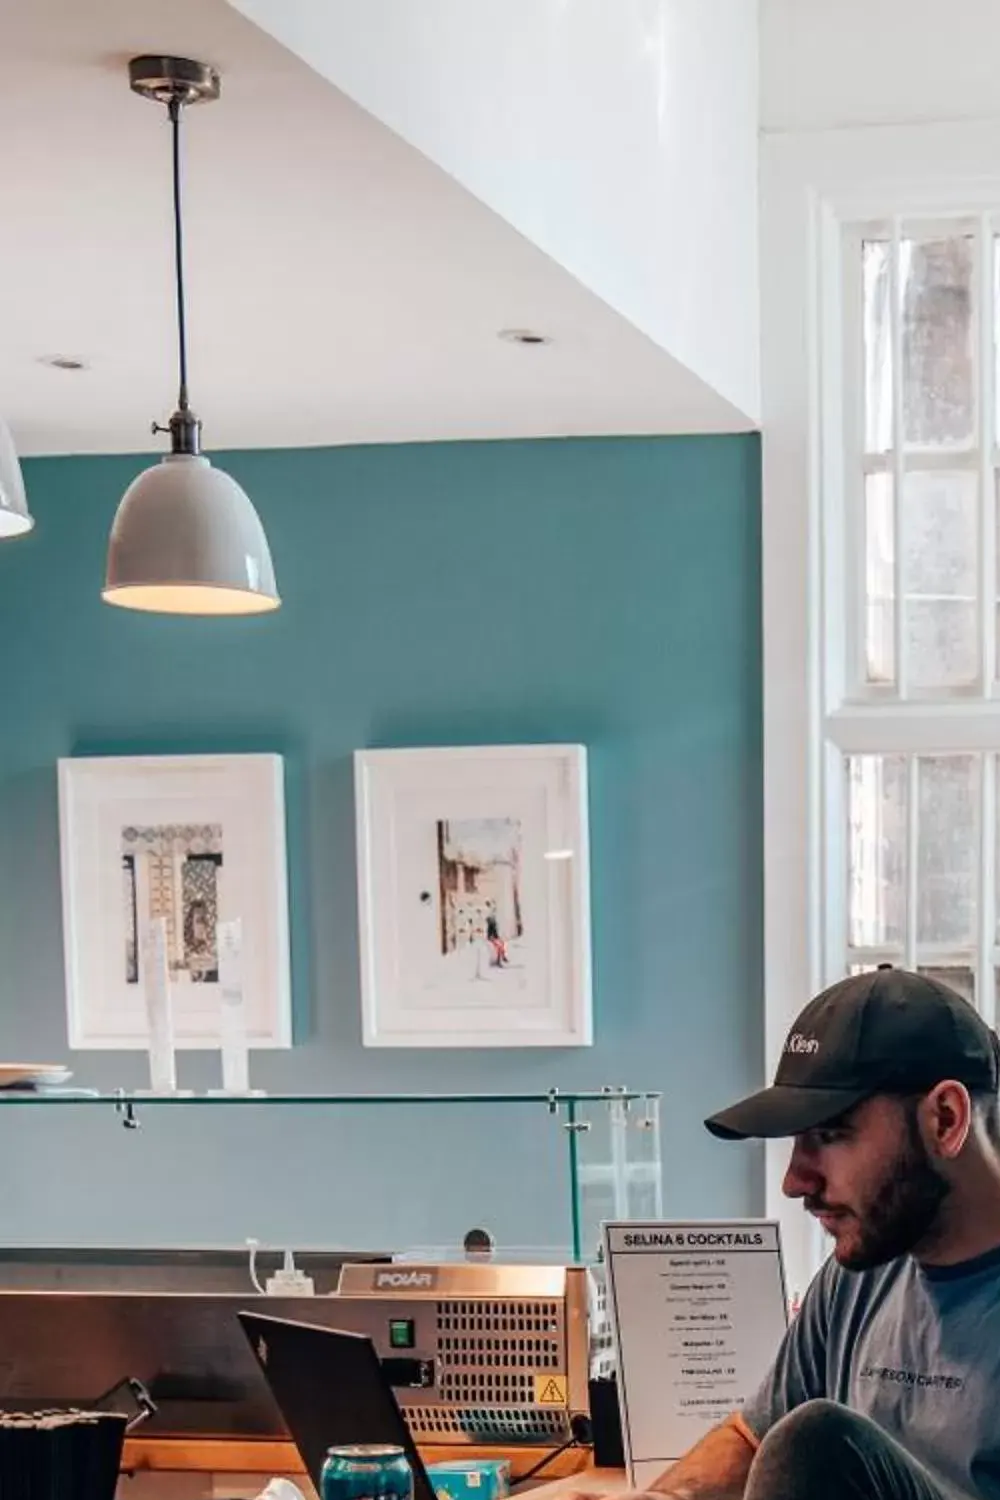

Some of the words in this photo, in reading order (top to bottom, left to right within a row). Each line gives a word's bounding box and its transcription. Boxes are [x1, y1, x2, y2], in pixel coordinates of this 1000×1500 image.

[624, 1233, 672, 1246] SELINA
[676, 1233, 684, 1245] 6
[687, 1233, 762, 1245] COCKTAILS
[377, 1271, 431, 1287] POLAR
